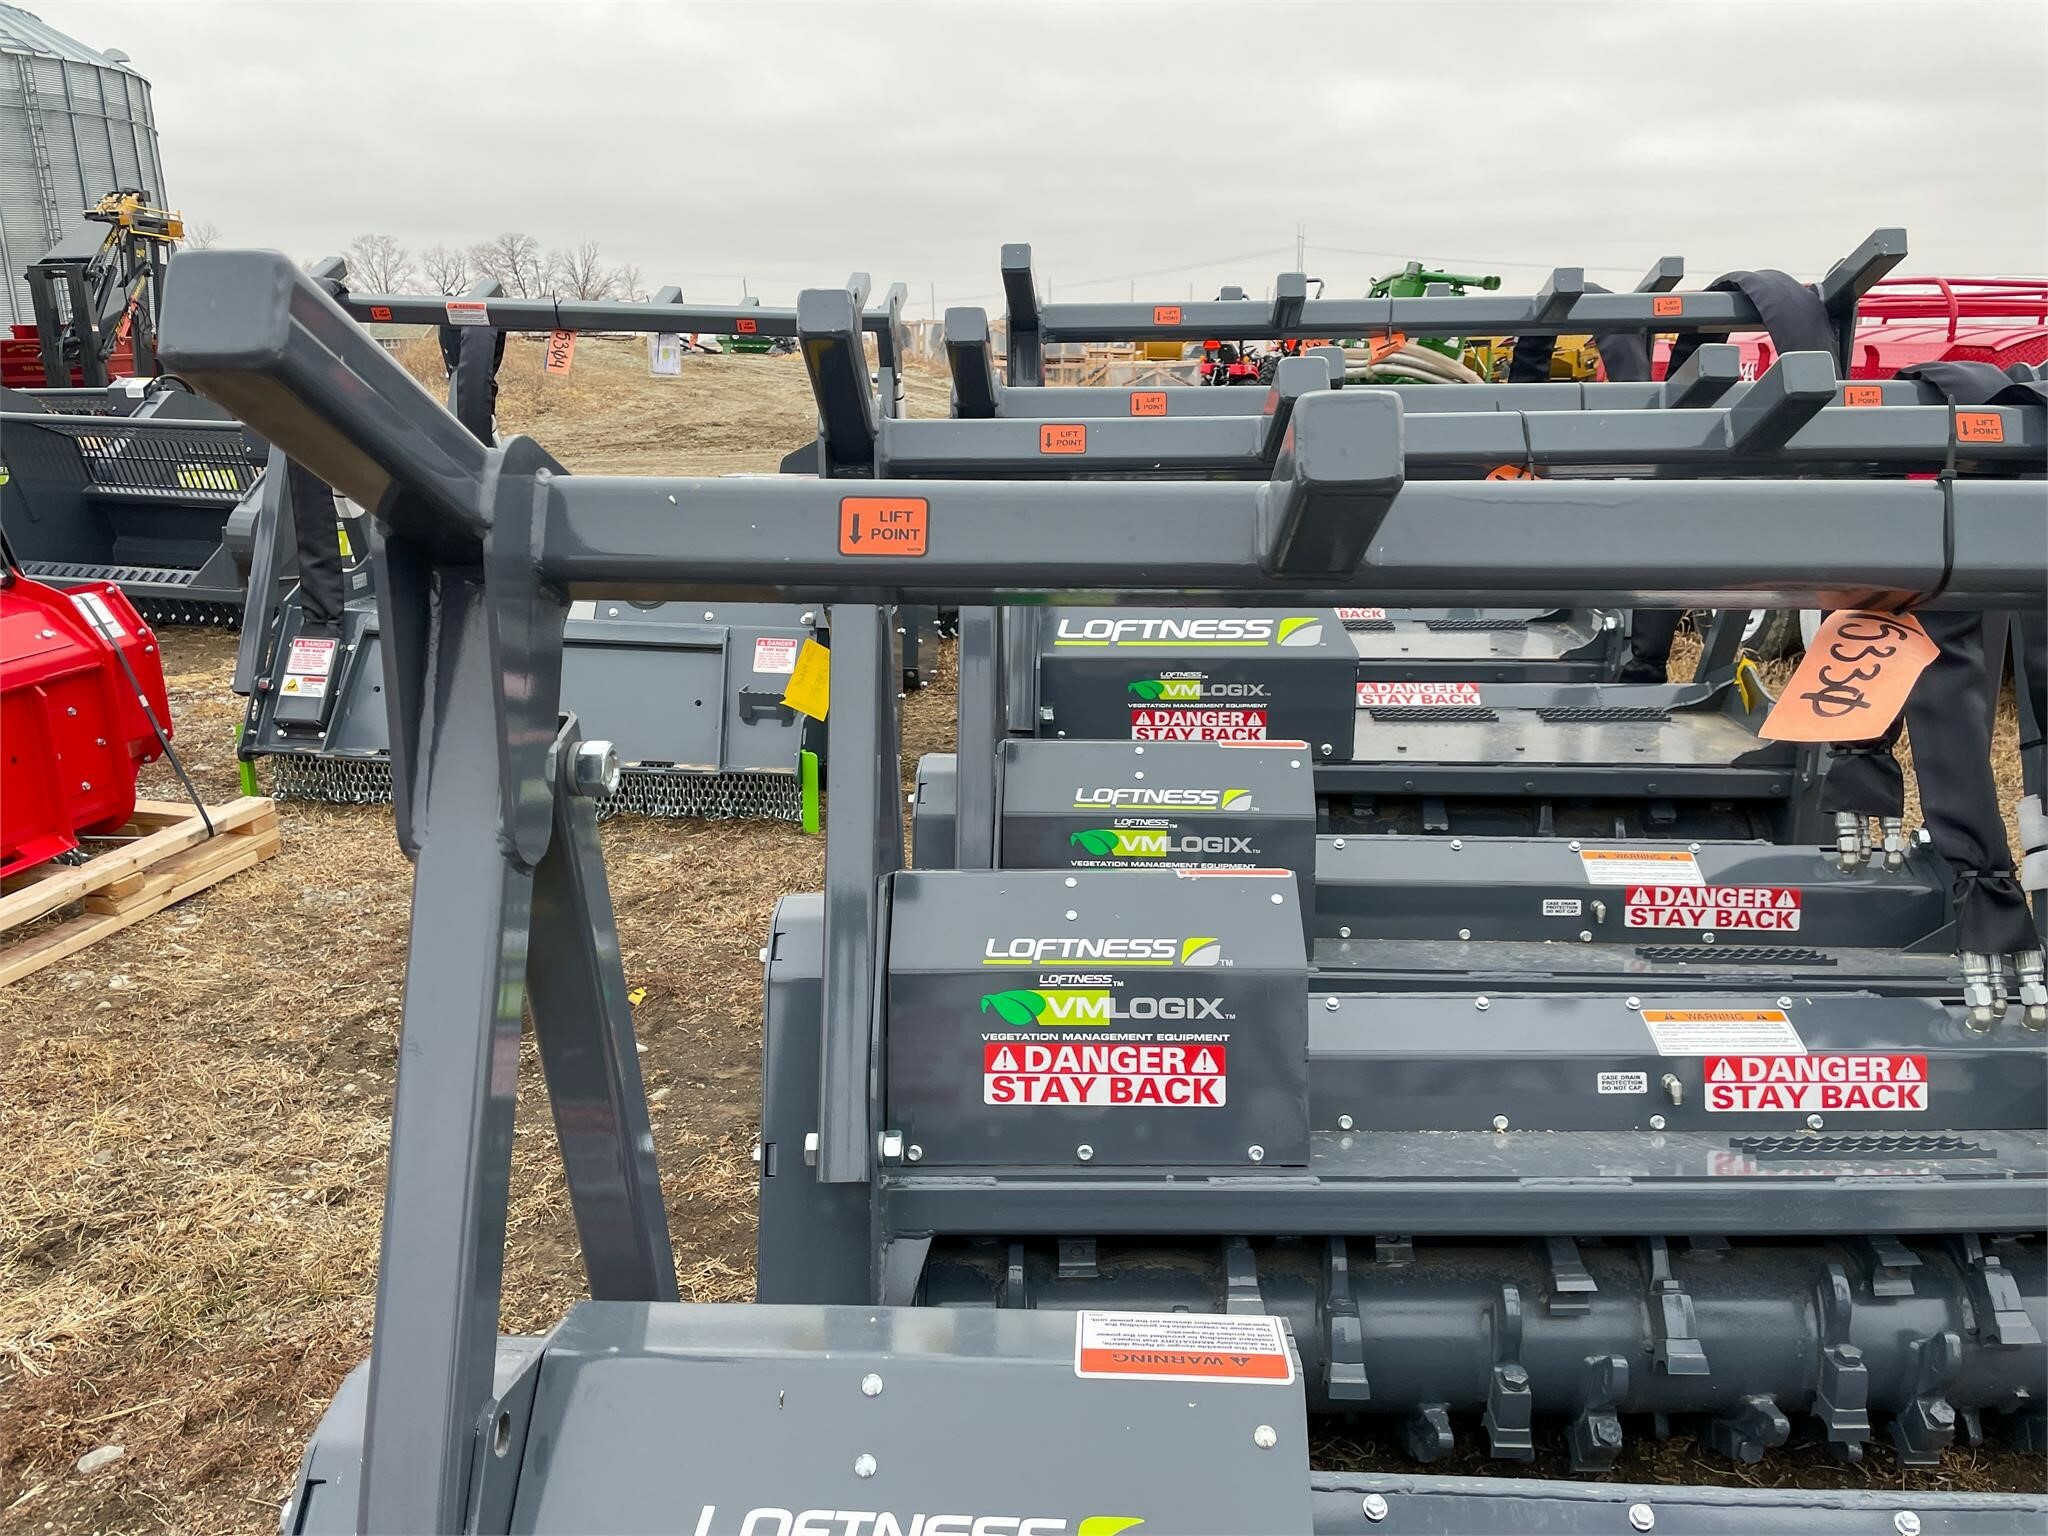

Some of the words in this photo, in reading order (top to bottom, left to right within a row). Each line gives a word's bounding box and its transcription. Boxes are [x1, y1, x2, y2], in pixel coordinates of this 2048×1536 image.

[880, 510, 914, 522] LIFT
[870, 528, 920, 541] POINT
[1339, 610, 1382, 618] BACK
[1057, 619, 1274, 642] LOFTNESS
[1378, 683, 1458, 693] DANGER
[1362, 694, 1414, 704] STAY
[1422, 695, 1476, 704] BACK
[1154, 712, 1245, 726] DANGER
[1136, 728, 1194, 740] STAY
[1202, 728, 1261, 740] BACK
[1076, 788, 1220, 806] LOFTNESS
[1114, 818, 1169, 826] LOFTNESS
[1655, 887, 1774, 908] DANGER
[1630, 909, 1707, 927] STAY
[1716, 911, 1795, 929] BACK
[985, 938, 1177, 960] LOFTNESS
[1040, 974, 1112, 985] LOFTNESS
[1684, 1012, 1744, 1021] WARNING
[981, 1033, 1058, 1041] VEGETATION
[1157, 1034, 1230, 1042] EQUIPMENT
[1025, 1046, 1186, 1074] DANGER
[1742, 1058, 1892, 1081] DANGER
[992, 1076, 1097, 1103] STAY
[1110, 1078, 1219, 1104] BACK
[1712, 1085, 1809, 1109] STAY
[1822, 1085, 1921, 1108] BACK
[1112, 1354, 1224, 1366] WARNING
